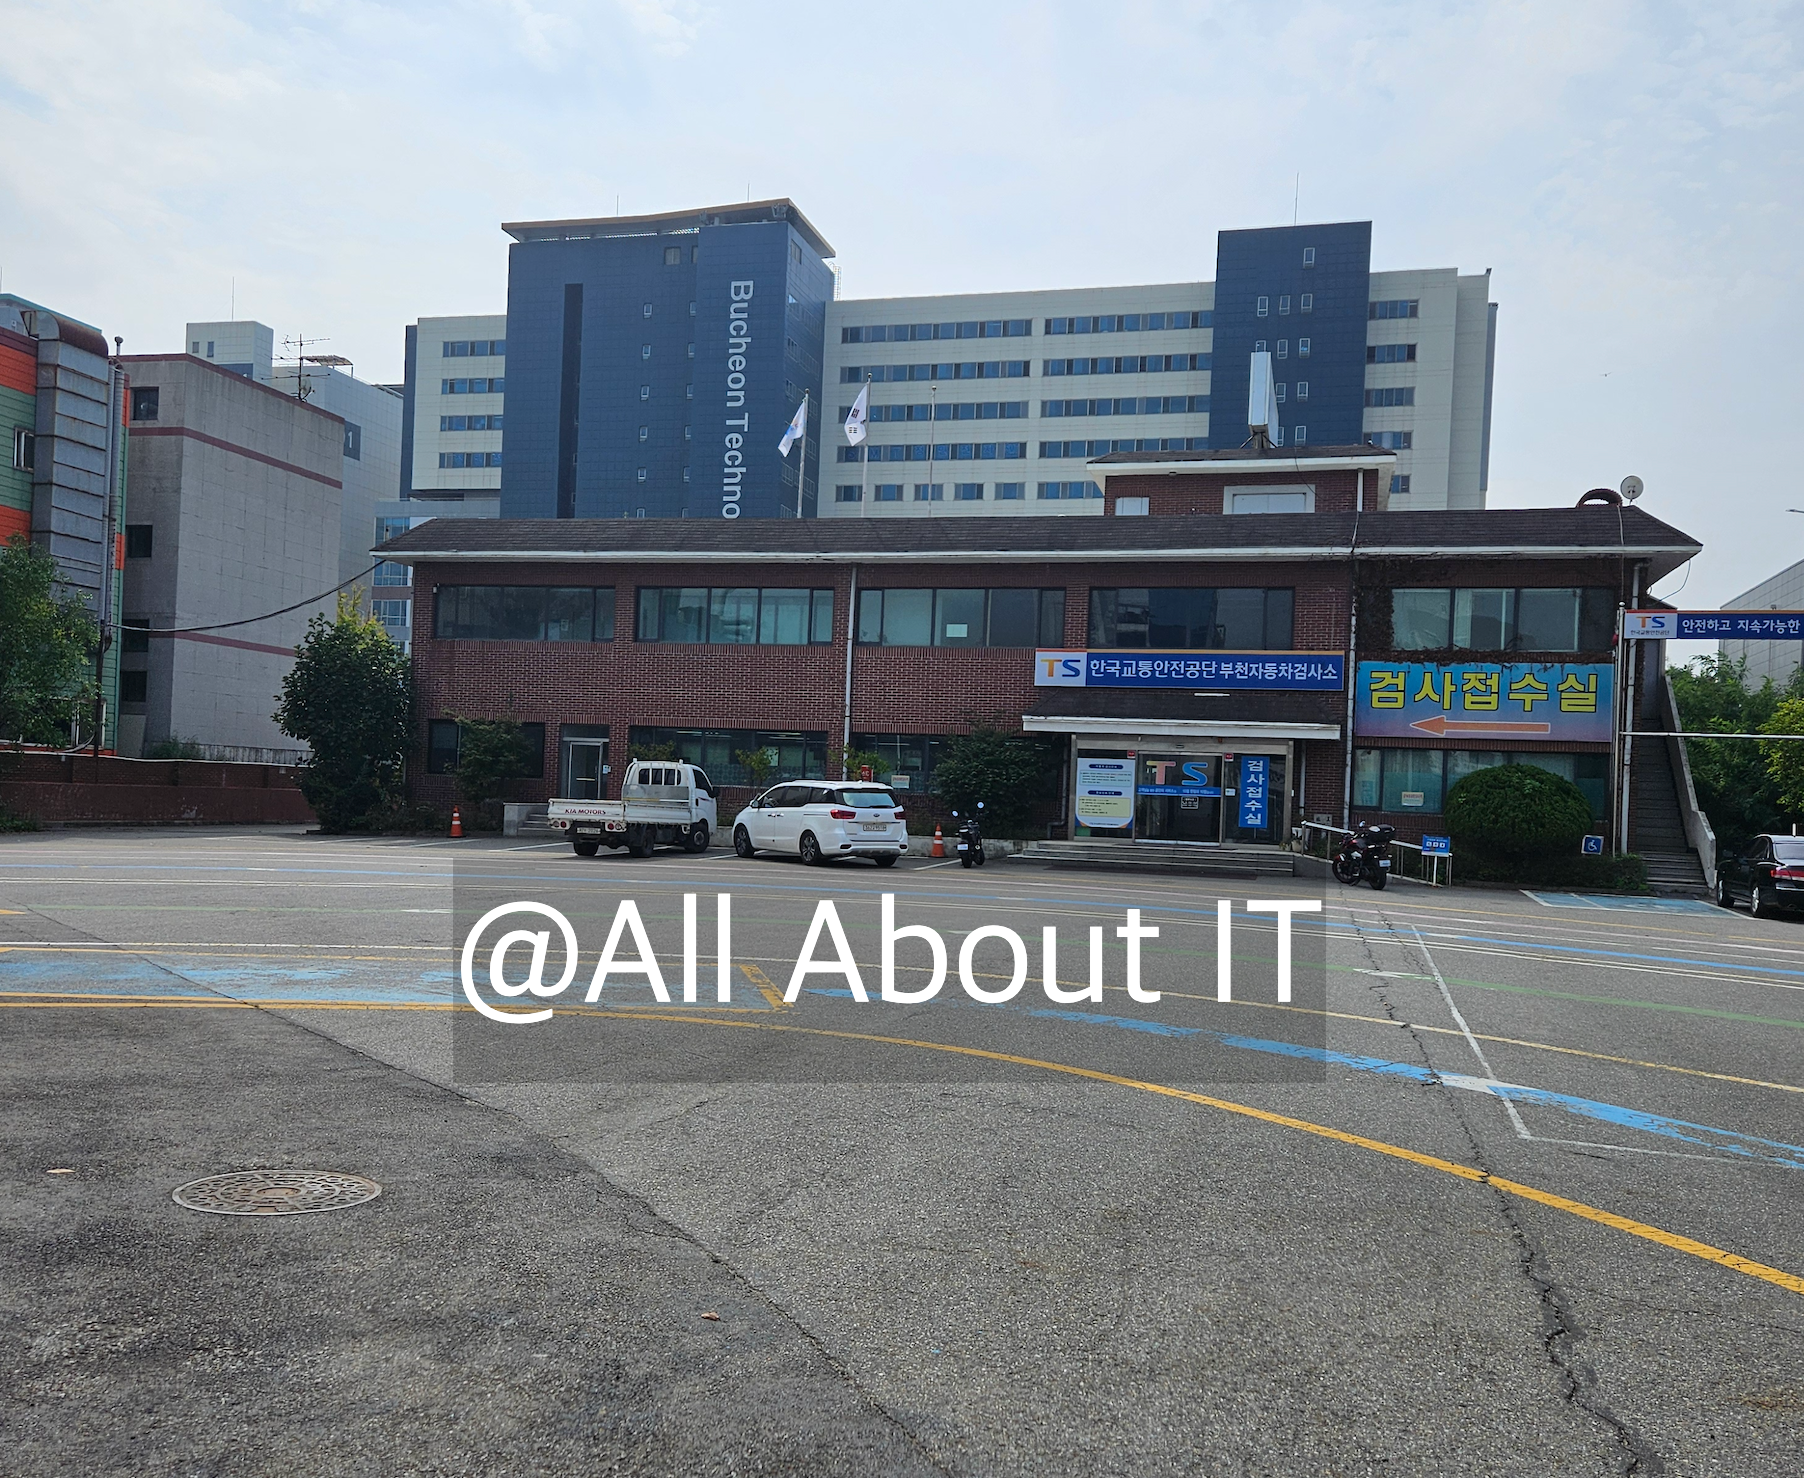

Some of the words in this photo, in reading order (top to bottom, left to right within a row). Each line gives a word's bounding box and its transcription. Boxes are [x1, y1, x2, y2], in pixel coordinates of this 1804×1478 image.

[727, 280, 754, 407] Bucheon
[721, 413, 749, 519] Techno
[1635, 616, 1666, 629] TS
[1682, 619, 1732, 634] 안전하고
[1737, 619, 1801, 634] 지속가능한
[1040, 658, 1081, 679] TS
[1089, 659, 1218, 680] 한국교통안전공단
[1219, 662, 1338, 681] 부천자동차검사소
[1370, 670, 1599, 714] 검사접수실
[1244, 760, 1265, 825] 검사접수실
